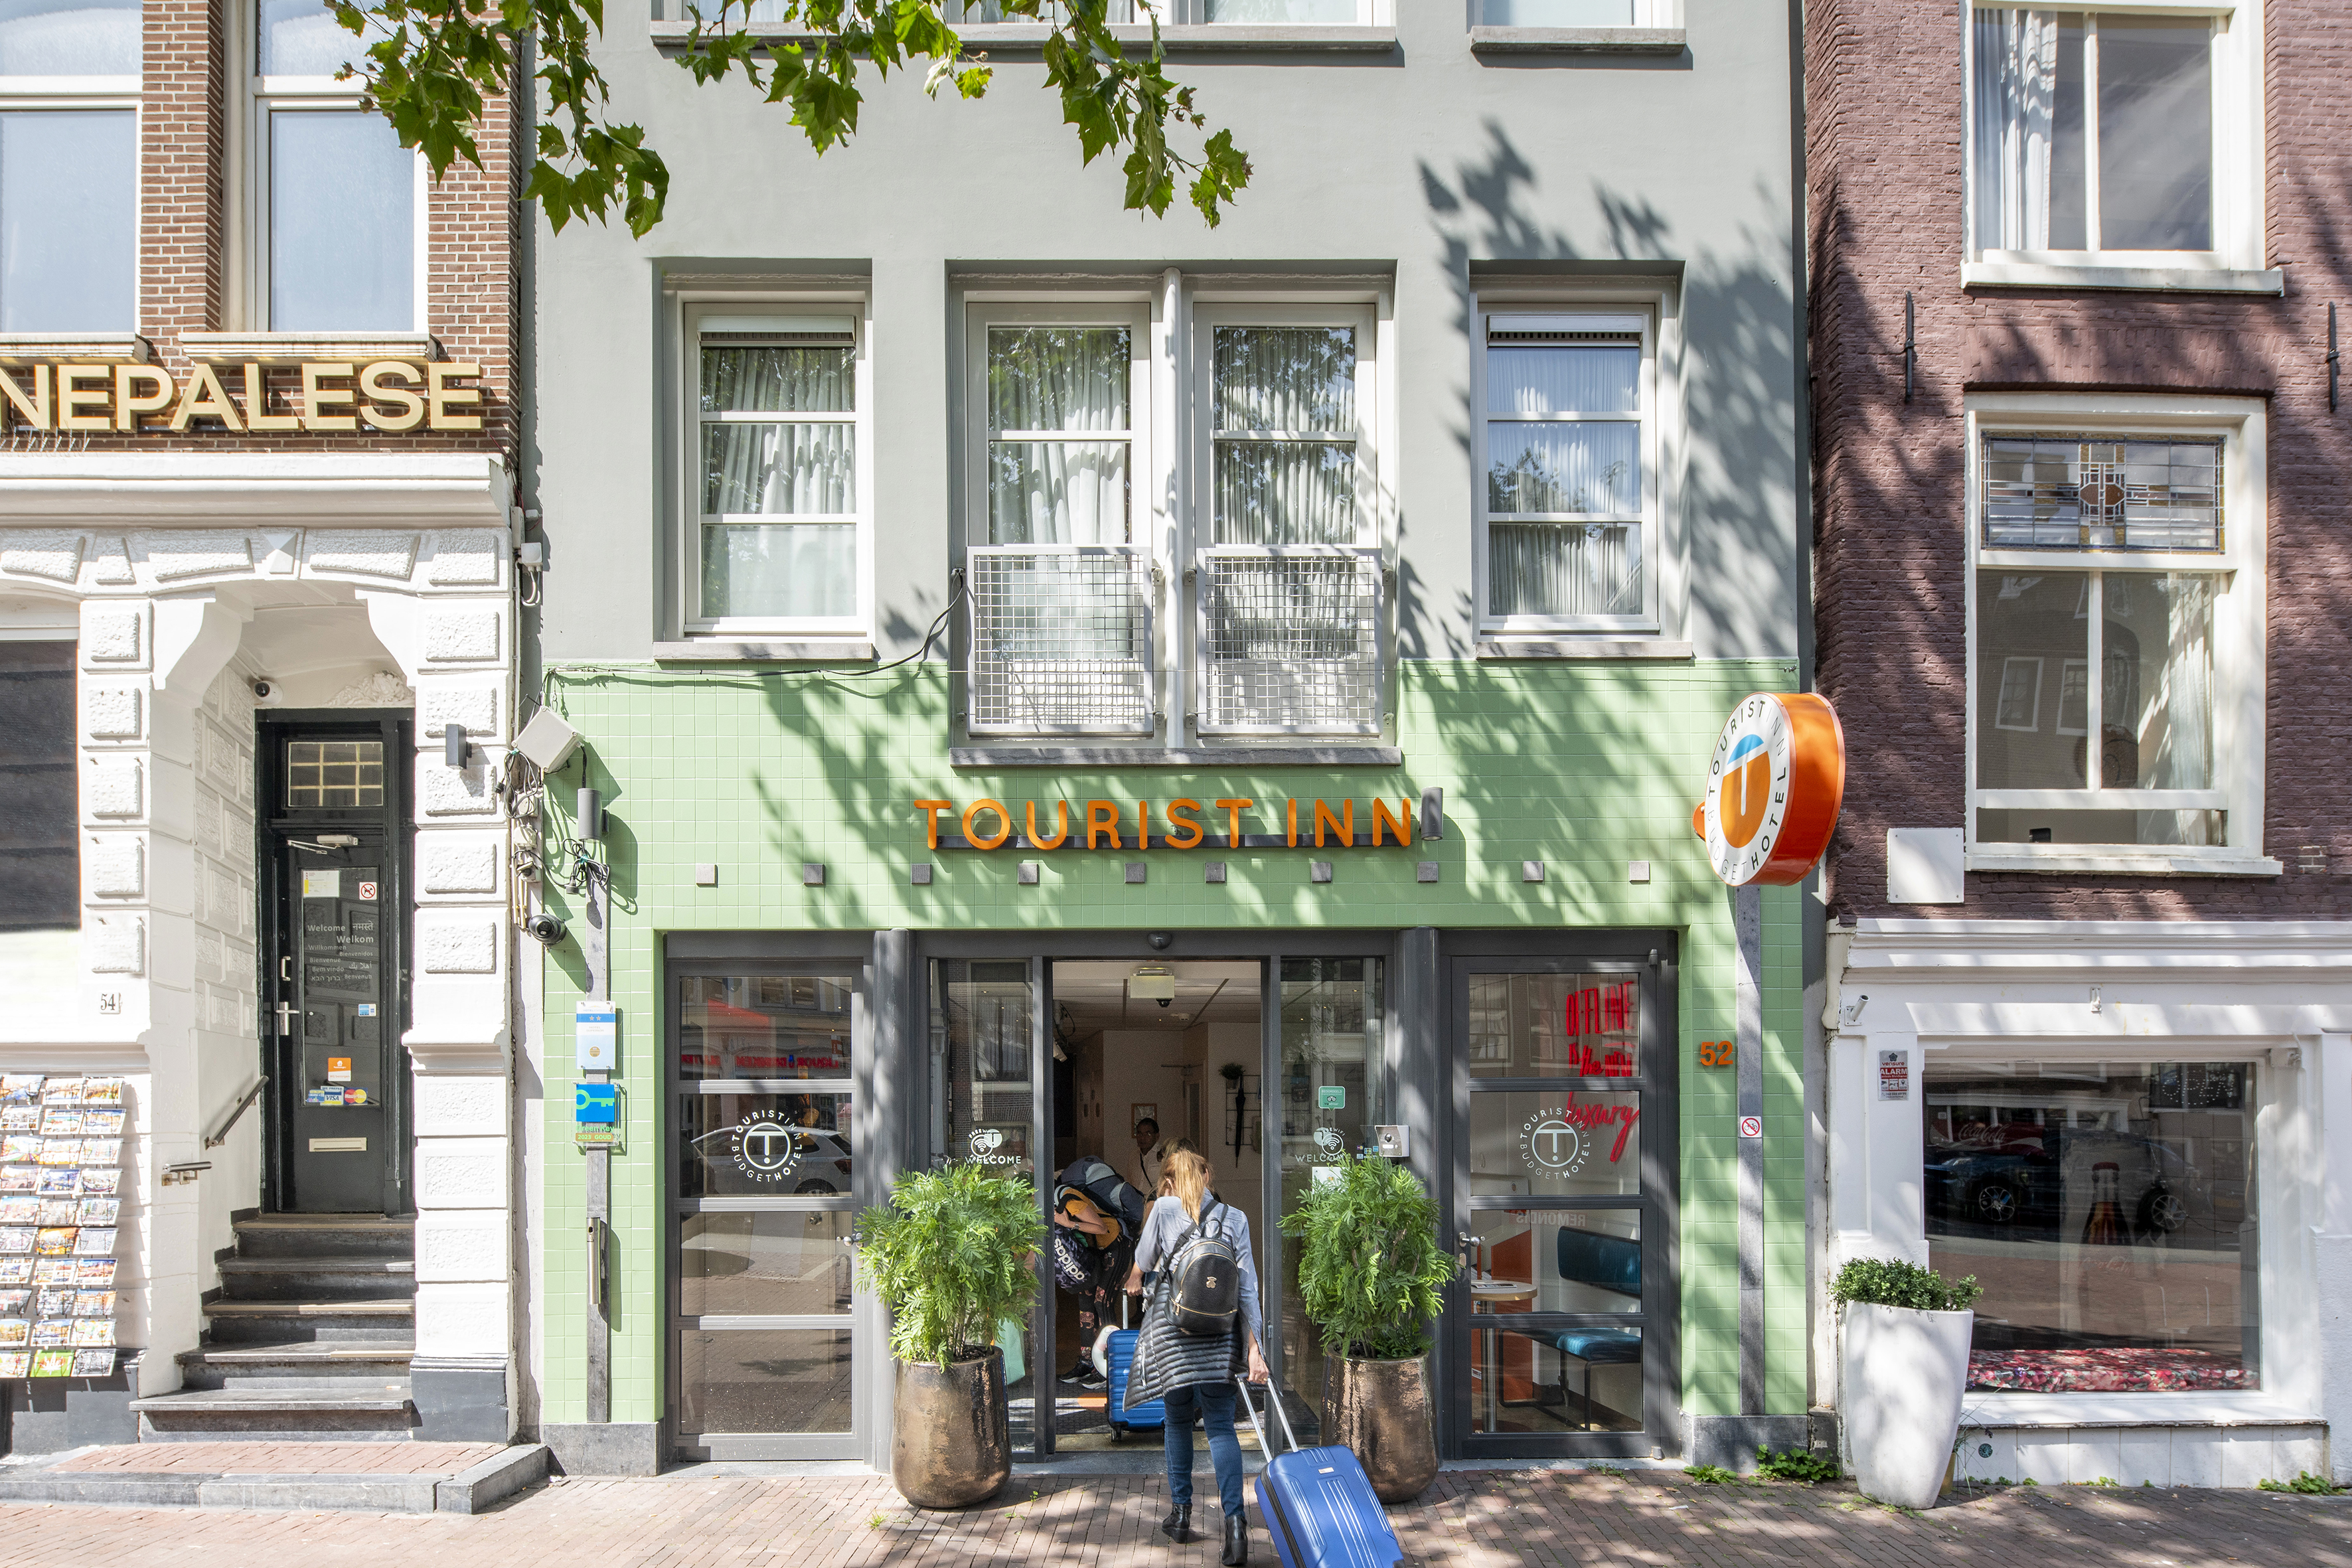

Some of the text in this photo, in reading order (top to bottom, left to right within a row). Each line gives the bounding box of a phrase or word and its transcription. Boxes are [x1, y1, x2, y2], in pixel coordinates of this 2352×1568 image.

[0, 360, 484, 433] NEPALESE
[1708, 700, 1786, 797] TOURIST INN
[913, 797, 1411, 850] TOURIST INN
[1707, 766, 1786, 880] BUDGET HOTEL
[336, 935, 374, 943] Welkom
[353, 920, 374, 931] नमस्ते
[100, 993, 116, 1010] 54
[1565, 981, 1634, 1037] OFFLINE
[1699, 1040, 1734, 1066] 52
[732, 1109, 802, 1141] TOURIST INN
[1520, 1107, 1589, 1139] TOURIST INN
[1565, 1091, 1640, 1162] luxury
[732, 1144, 803, 1182] BUDGET HOTEL
[1520, 1141, 1591, 1180] BUDGET HOTEL
[1054, 1238, 1085, 1280] adidas
